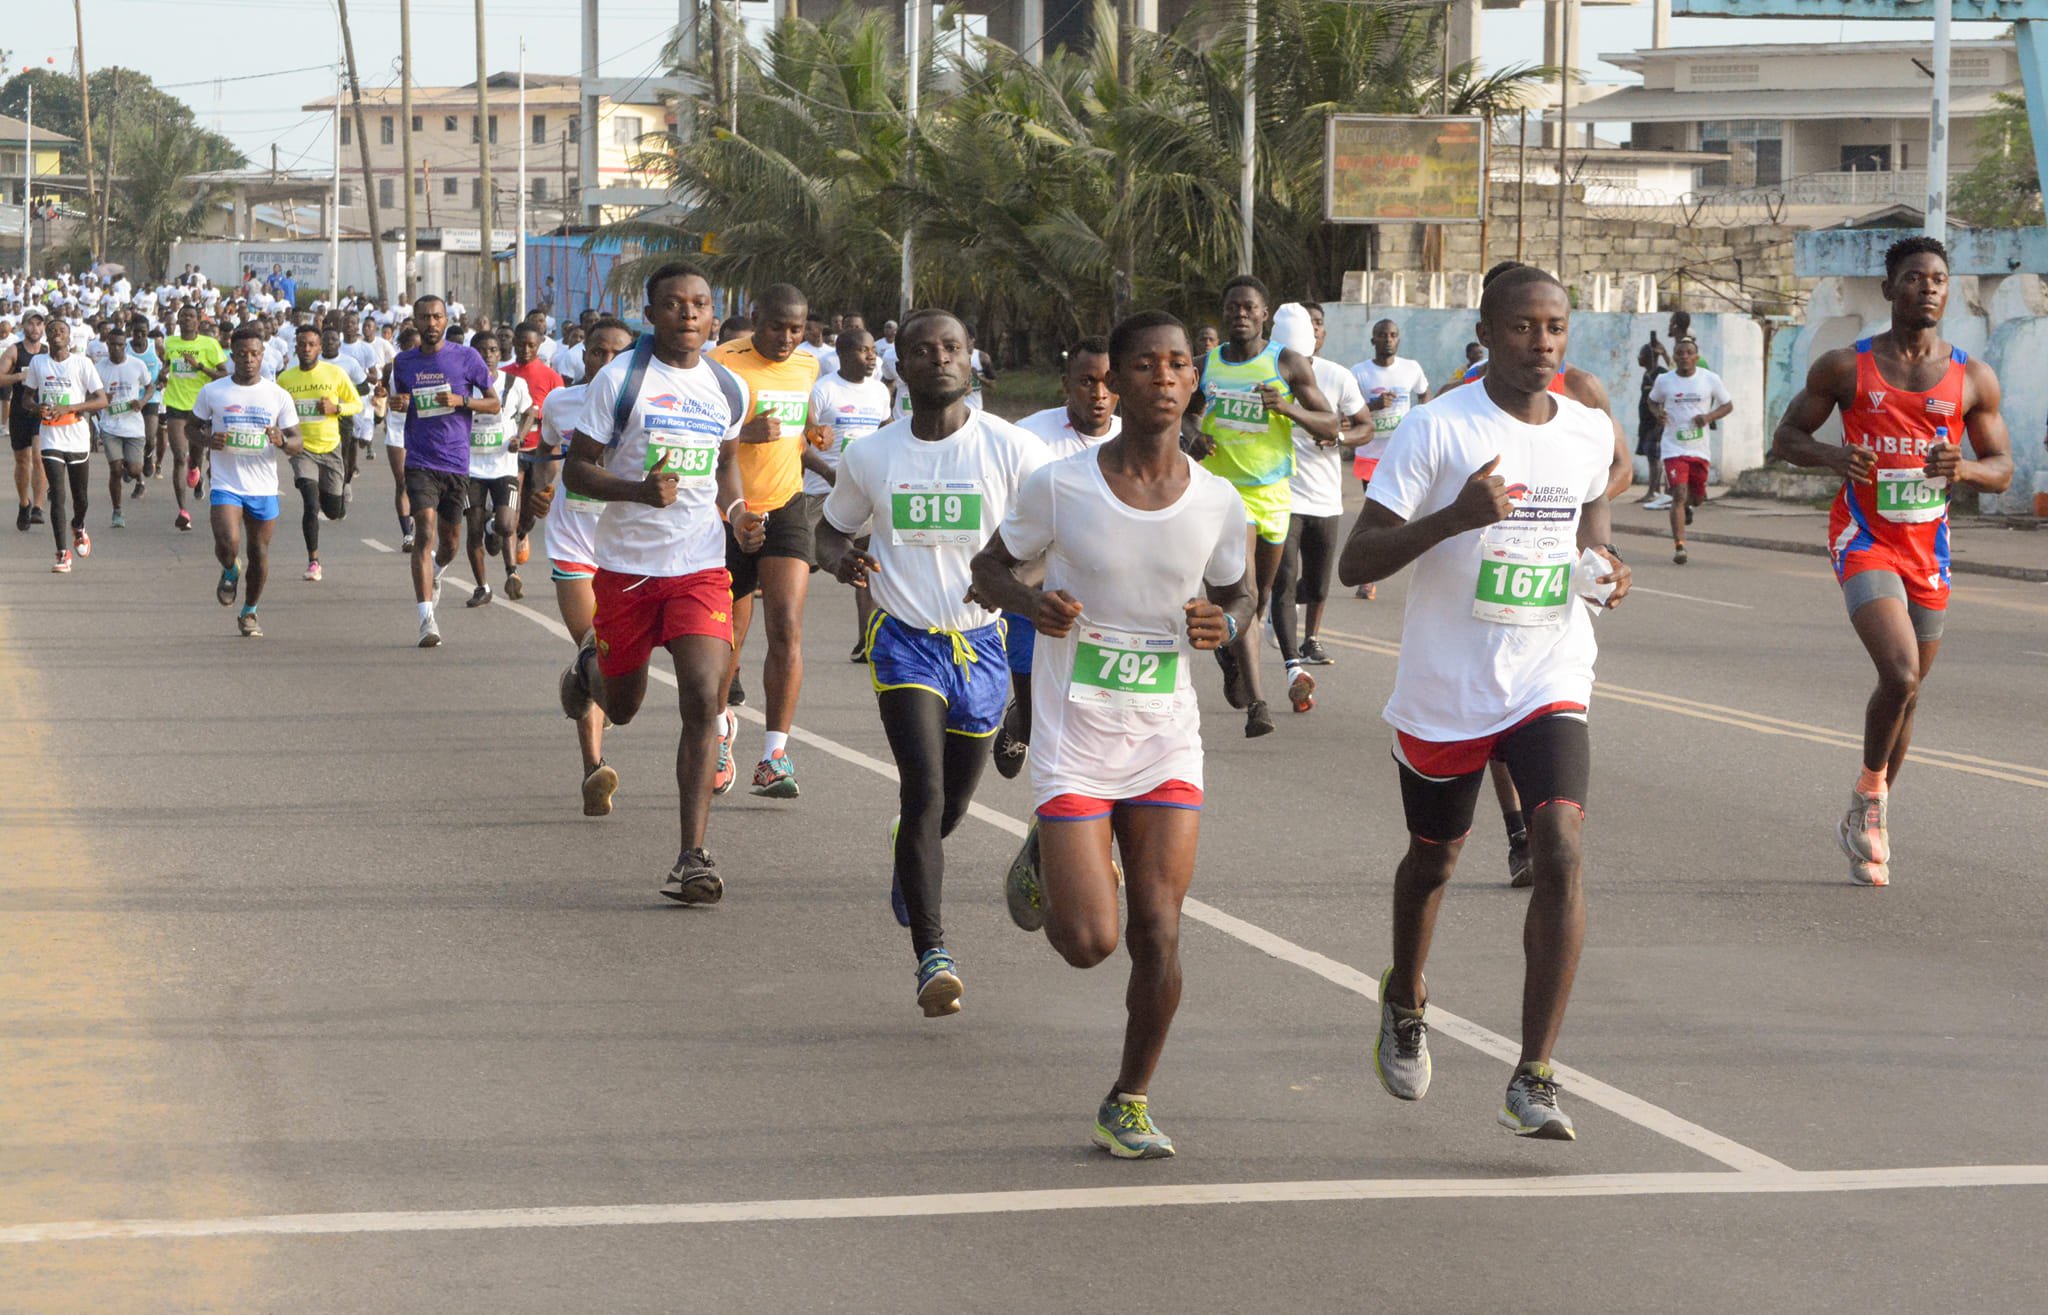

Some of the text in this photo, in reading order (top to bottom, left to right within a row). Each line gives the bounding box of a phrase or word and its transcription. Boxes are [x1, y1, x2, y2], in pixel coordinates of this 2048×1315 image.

[417, 393, 440, 408] 17
[1221, 398, 1264, 420] 1473
[651, 417, 667, 425] The
[667, 418, 685, 427] Race
[1863, 433, 1928, 456] LIBER
[1535, 486, 1569, 495] LIBERIA
[909, 495, 962, 523] 819
[1513, 510, 1535, 518] Race
[1492, 564, 1565, 599] 1674
[1098, 648, 1160, 685] 792
